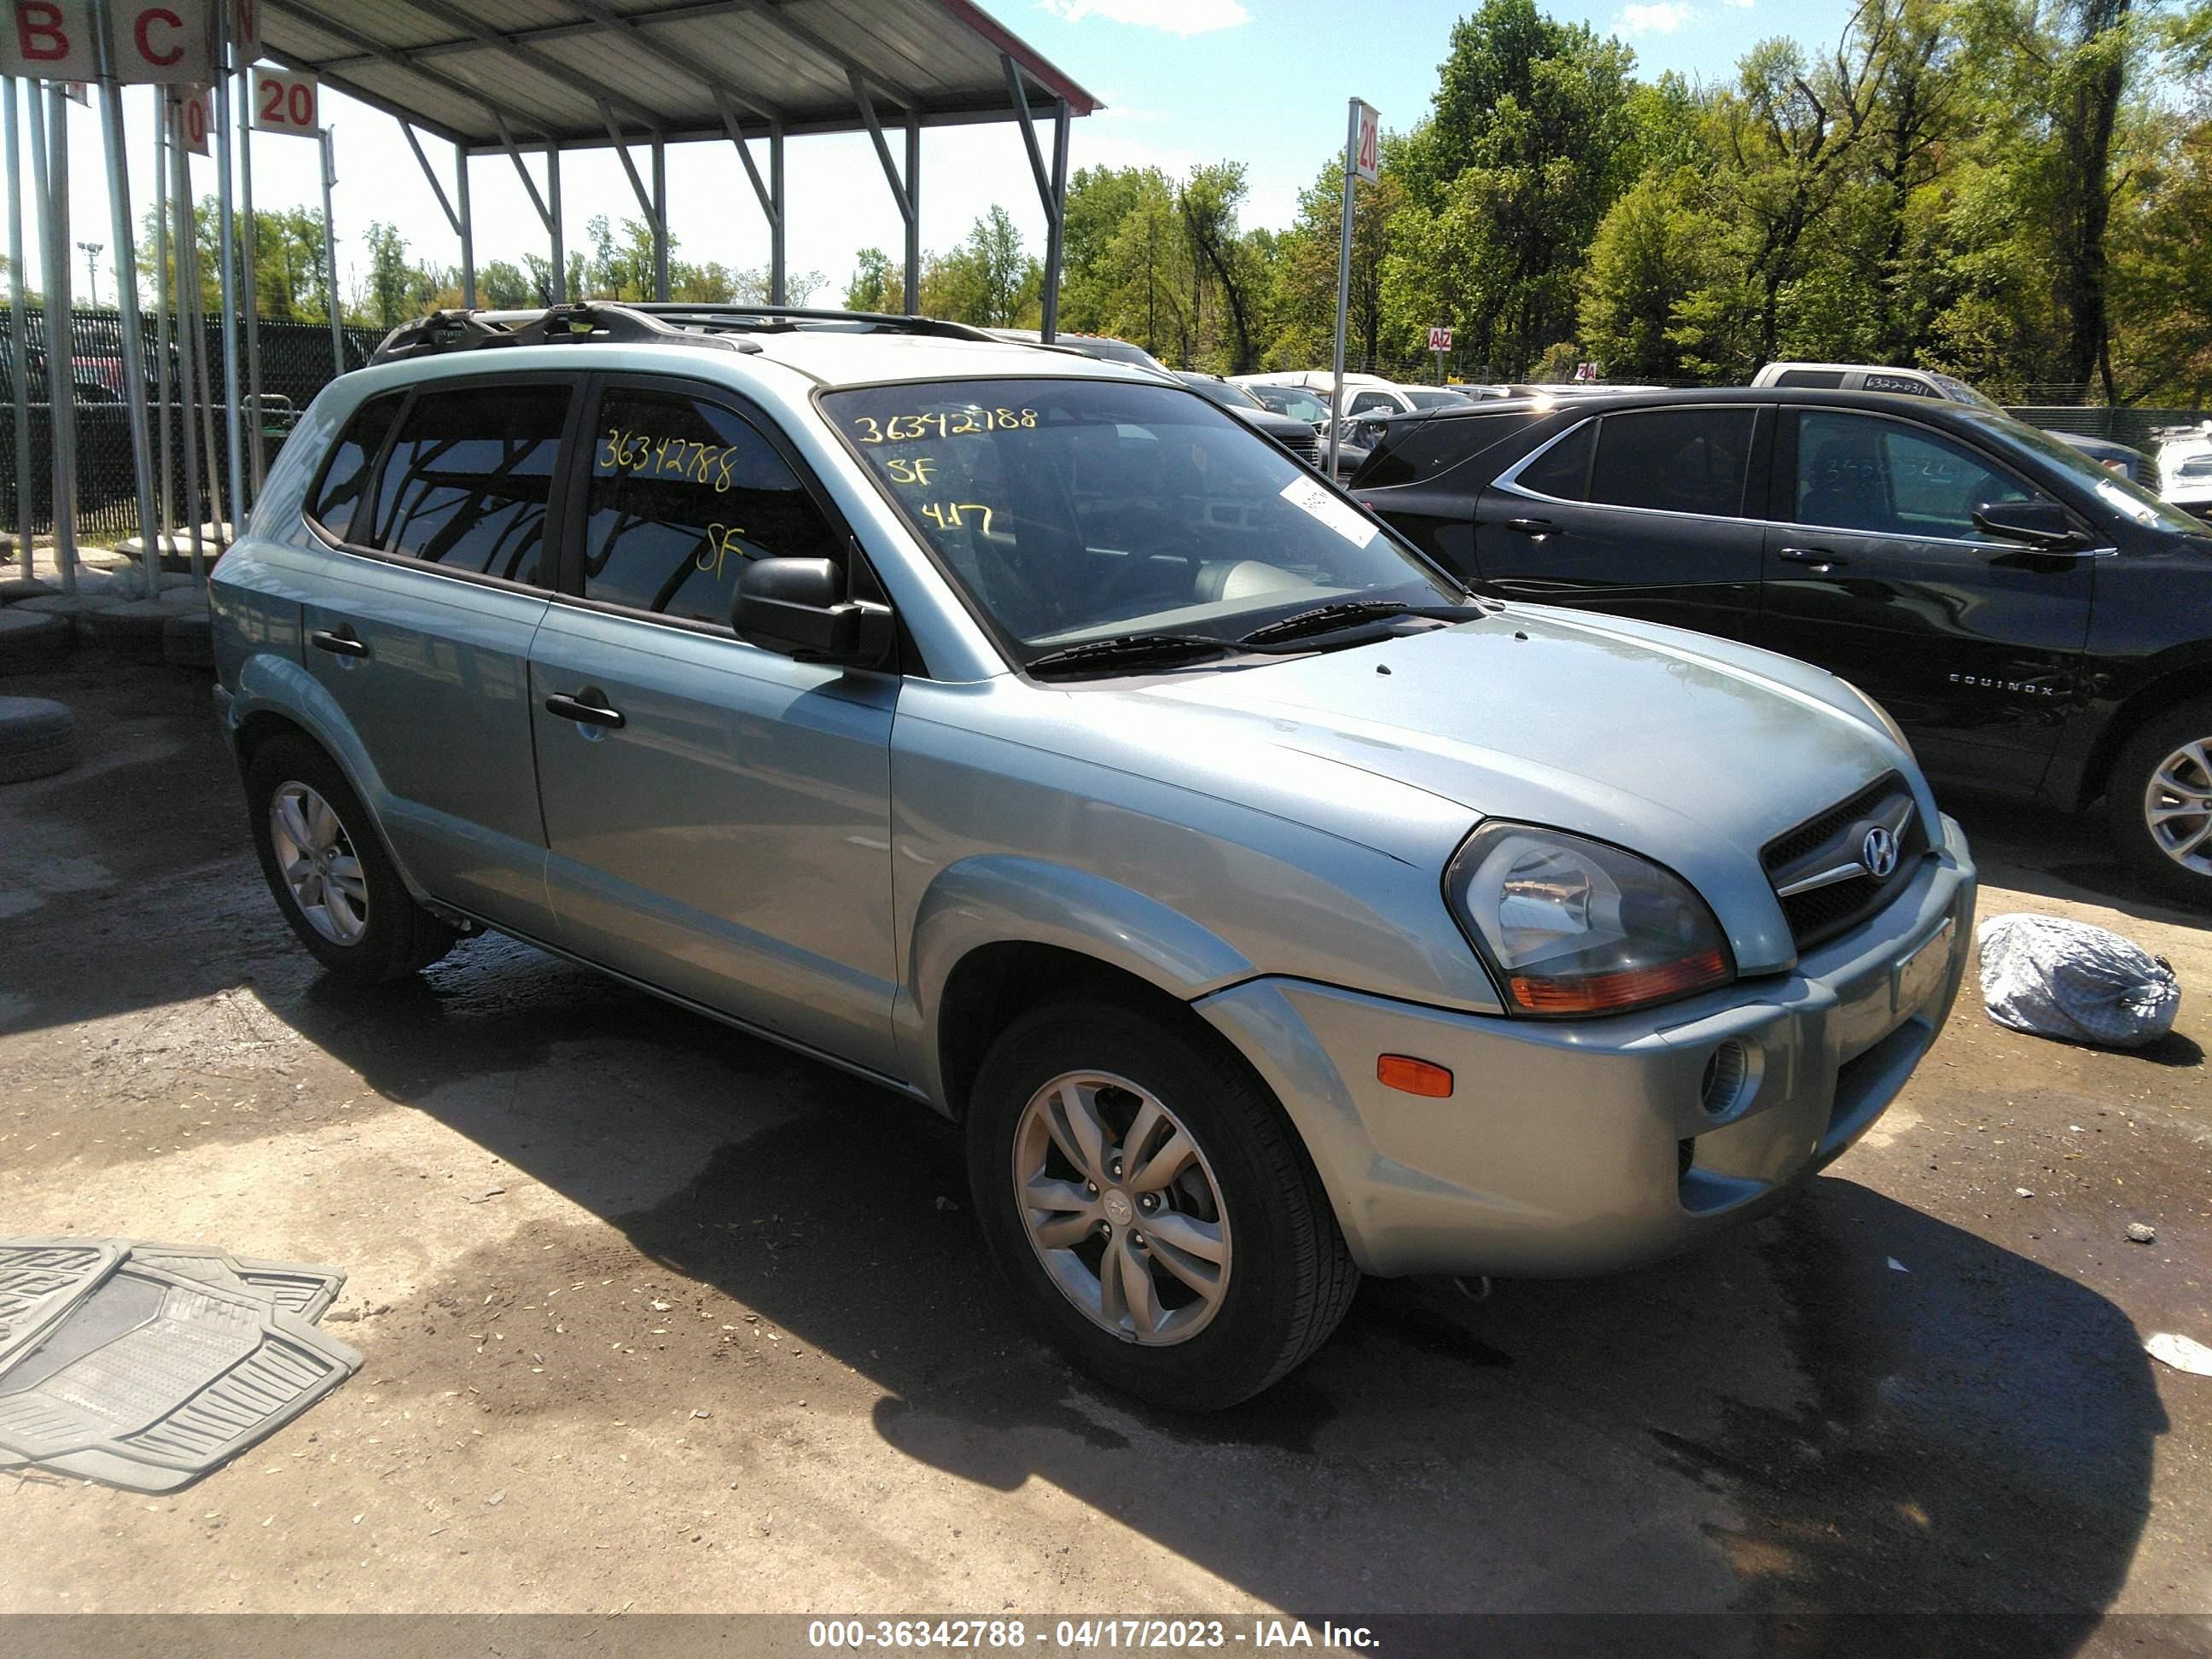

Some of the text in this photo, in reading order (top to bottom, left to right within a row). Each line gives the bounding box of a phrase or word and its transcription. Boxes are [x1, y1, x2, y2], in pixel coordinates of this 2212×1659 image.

[15, 1, 69, 61] B
[133, 8, 185, 66] C
[259, 79, 313, 126] 20
[1359, 119, 1376, 172] 20
[854, 408, 1039, 443] 36342788
[600, 428, 738, 492] 36342788
[887, 457, 938, 486] SF
[696, 522, 745, 583] SF
[1949, 673, 2053, 696] EQUINOX
